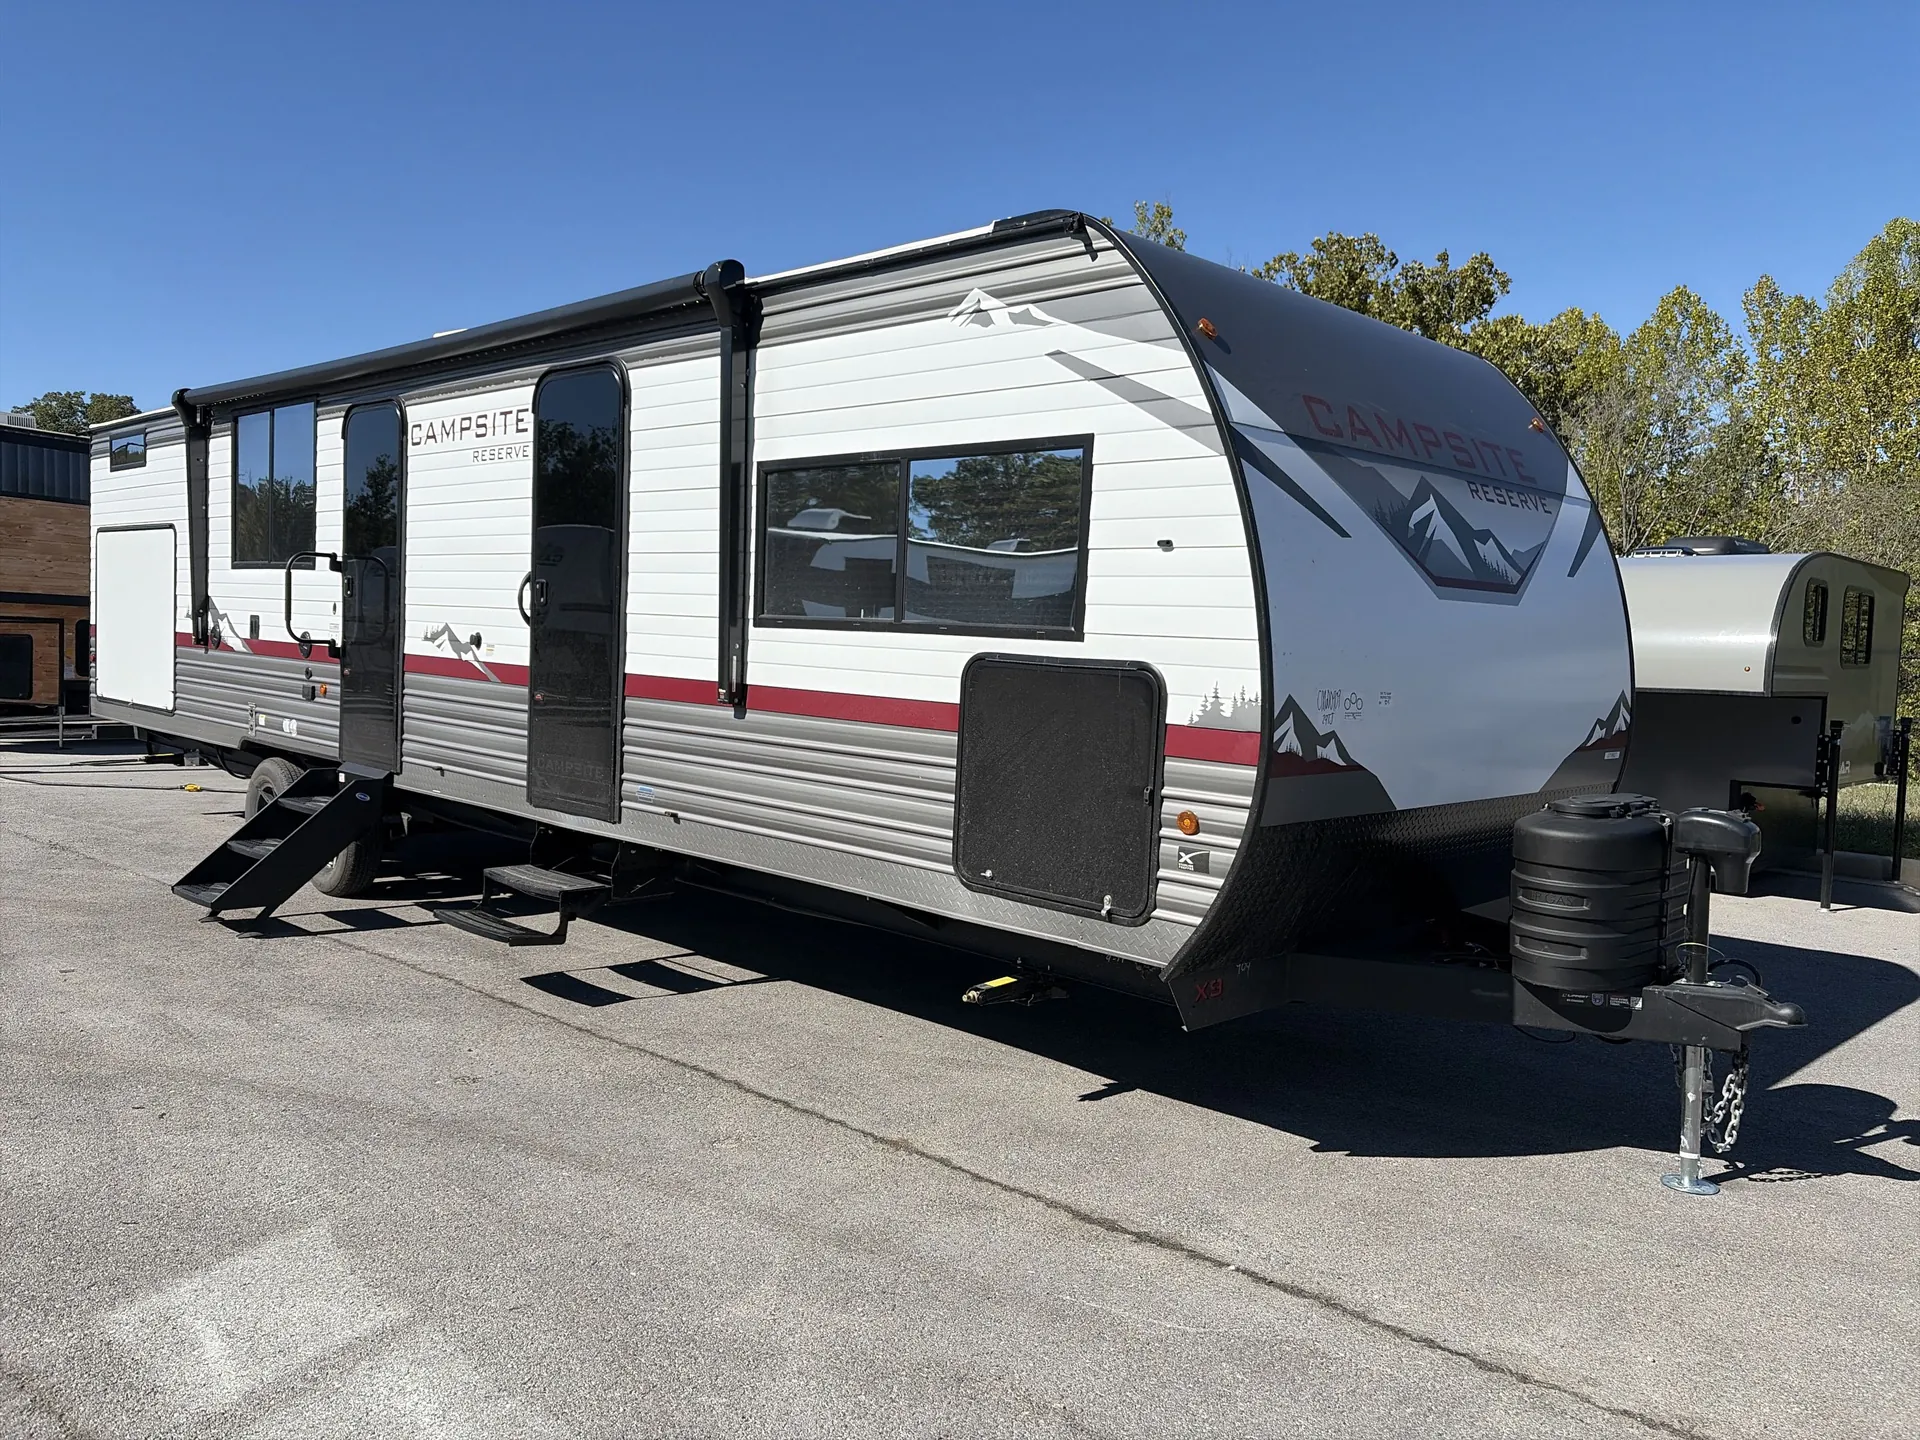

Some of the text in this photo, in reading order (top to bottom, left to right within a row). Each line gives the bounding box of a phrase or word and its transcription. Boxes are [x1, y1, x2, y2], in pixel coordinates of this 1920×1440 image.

[410, 408, 530, 447] CAMPSITE
[1301, 393, 1538, 485] CAMPSITE
[472, 445, 530, 463] RESERVE
[1466, 481, 1553, 515] RESERVE
